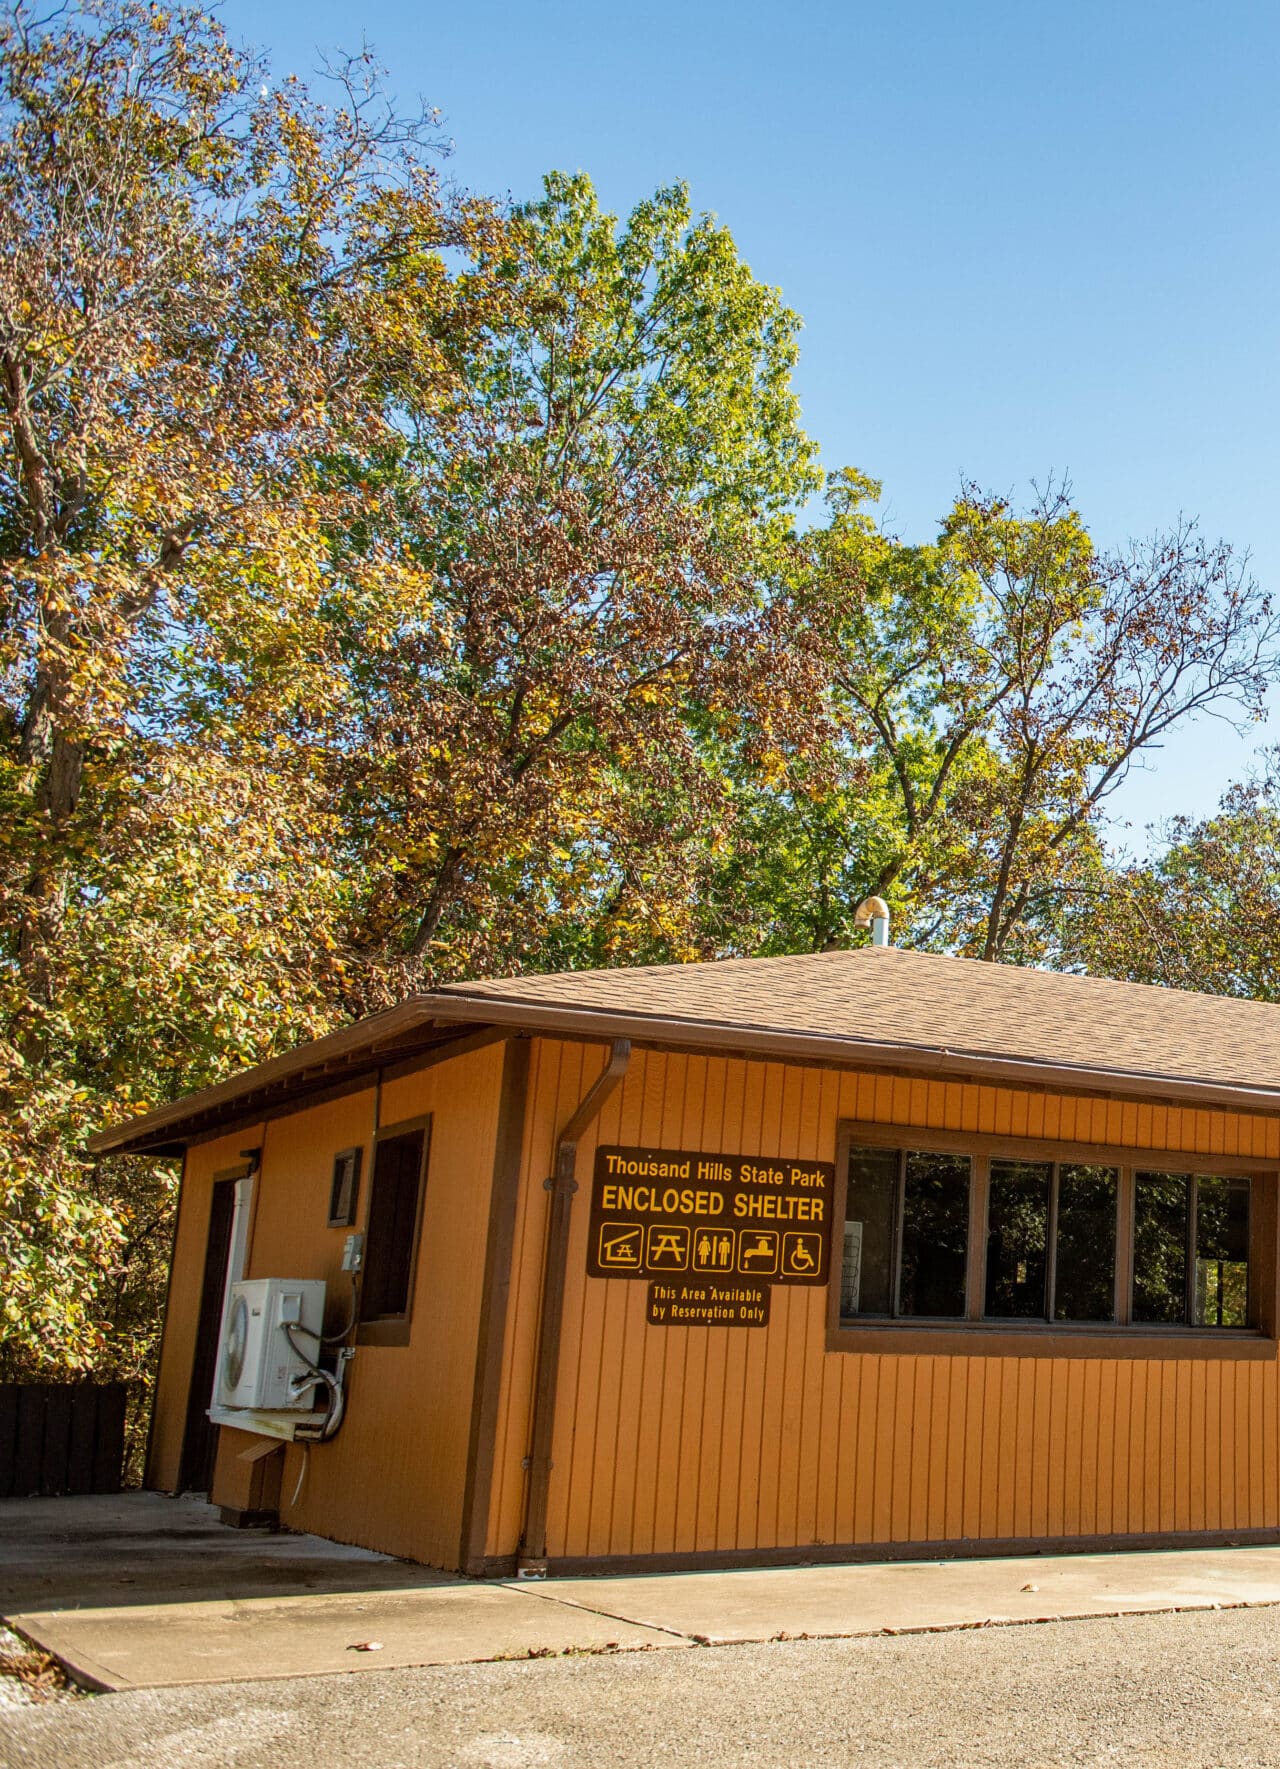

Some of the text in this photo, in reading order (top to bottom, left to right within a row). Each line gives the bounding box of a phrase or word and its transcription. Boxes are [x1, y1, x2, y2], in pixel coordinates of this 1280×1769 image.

[606, 1155, 825, 1187] Thousand Hills State Park
[602, 1185, 824, 1221] ENCLOSED SHELTER
[654, 1286, 762, 1302] This Area Available
[652, 1305, 764, 1321] by Reservation Only
